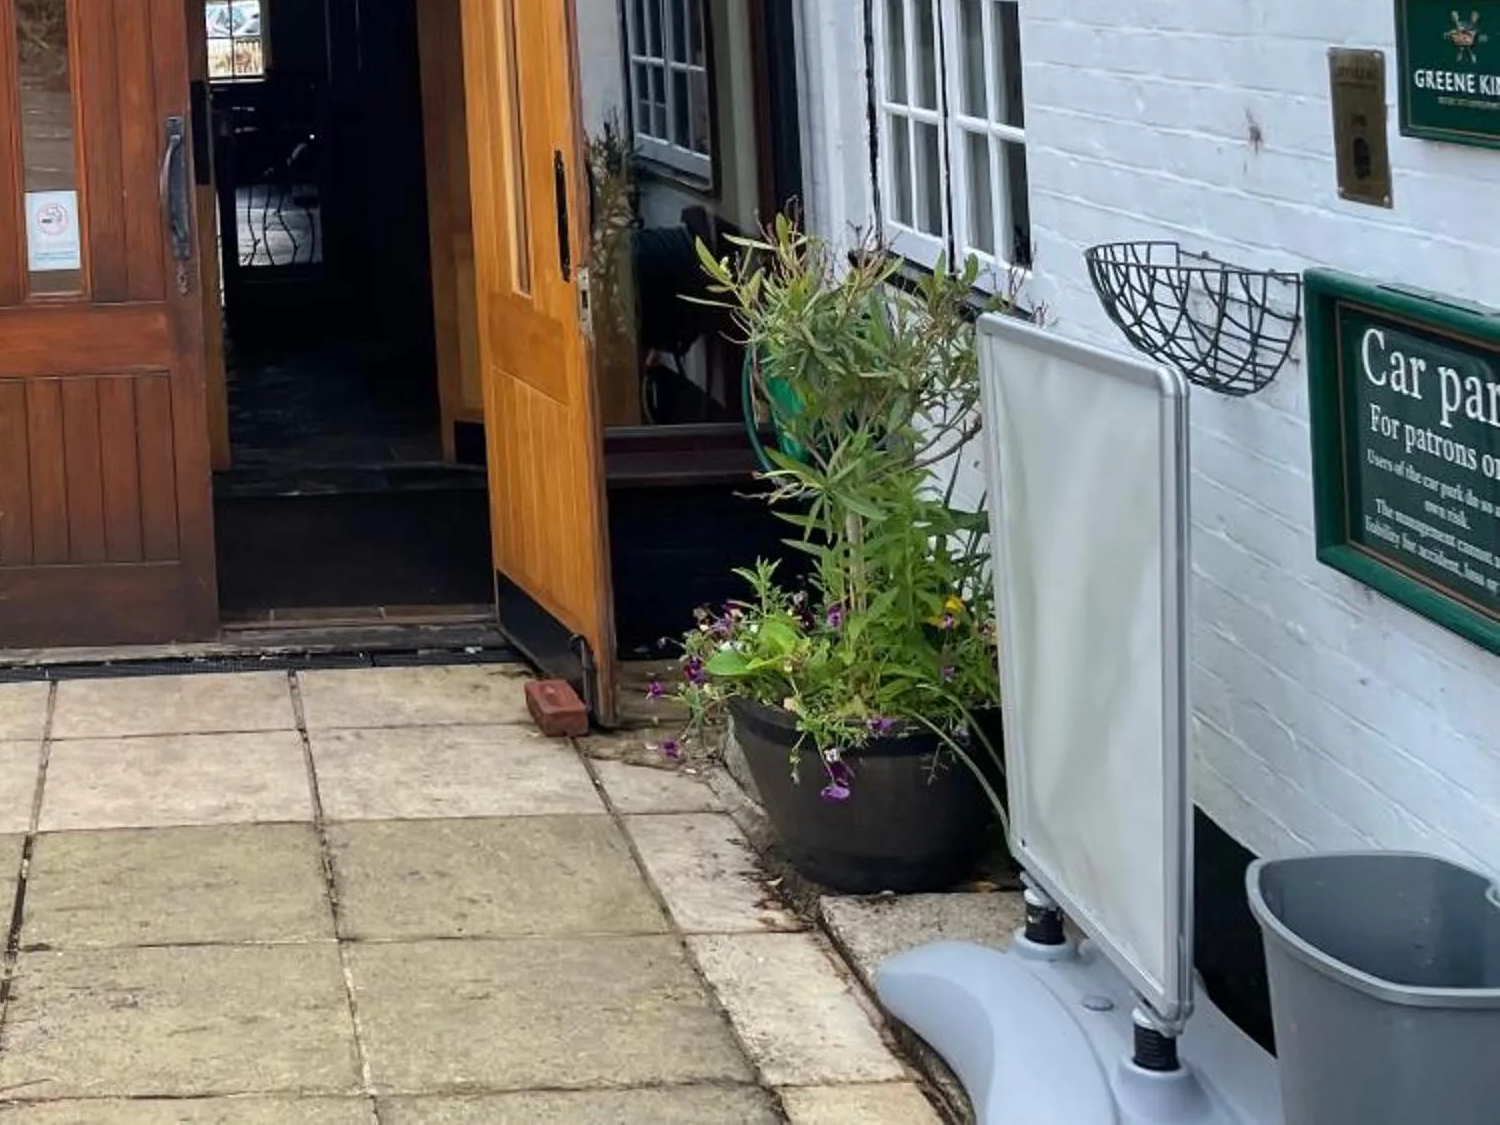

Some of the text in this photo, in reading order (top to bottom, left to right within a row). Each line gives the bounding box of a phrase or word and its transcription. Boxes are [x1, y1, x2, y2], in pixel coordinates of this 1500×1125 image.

[1414, 68, 1476, 94] GREENE
[1362, 328, 1427, 400] Car
[1369, 402, 1400, 440] For
[1404, 424, 1478, 471] patrons
